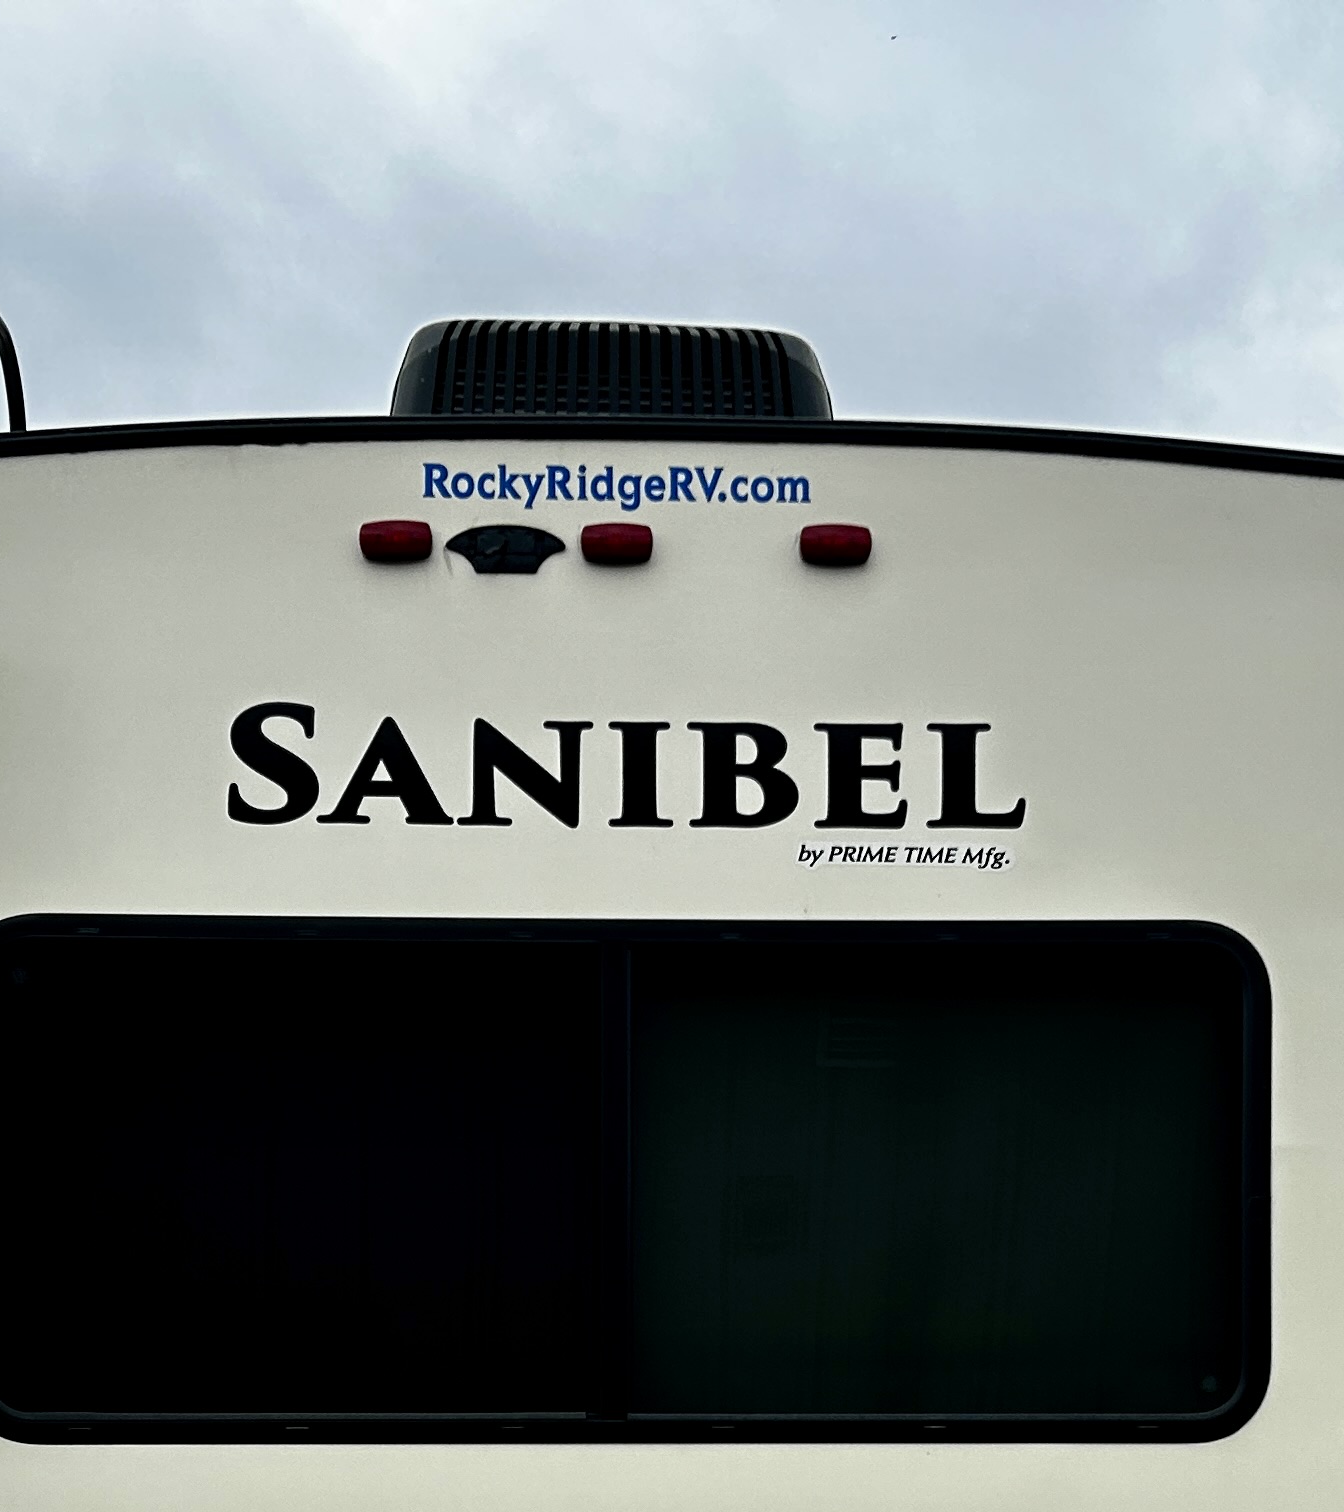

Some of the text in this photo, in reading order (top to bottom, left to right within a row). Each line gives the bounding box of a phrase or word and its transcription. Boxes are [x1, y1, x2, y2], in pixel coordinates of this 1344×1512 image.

[422, 462, 812, 512] RockyRidgeRV.com
[227, 701, 1027, 830] SANIBEL
[798, 844, 1010, 870] by PRIME TIME Mfg.
